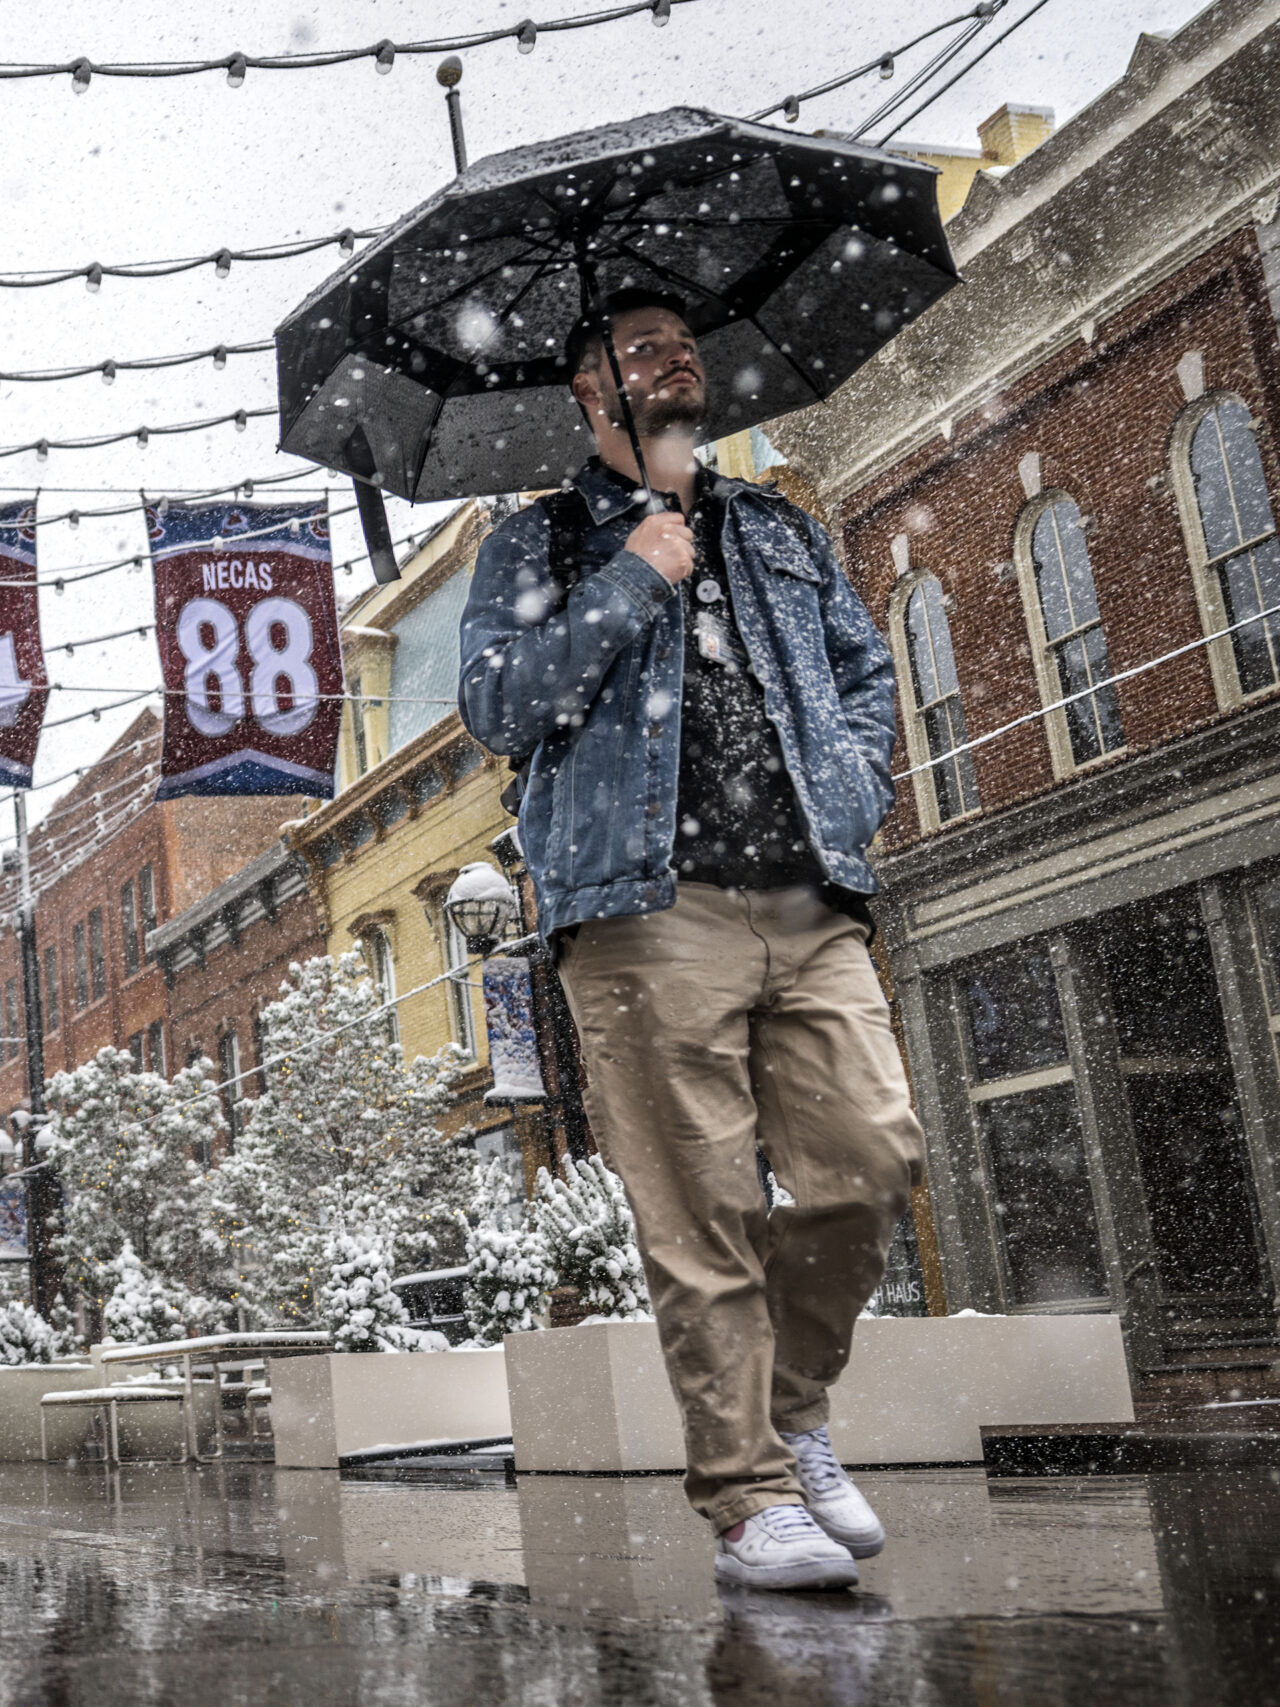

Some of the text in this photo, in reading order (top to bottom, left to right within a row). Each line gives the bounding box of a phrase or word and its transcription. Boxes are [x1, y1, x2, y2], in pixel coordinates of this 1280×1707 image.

[201, 560, 273, 591] NECAS
[177, 596, 320, 738] 88
[886, 1281, 921, 1304] HAUS
